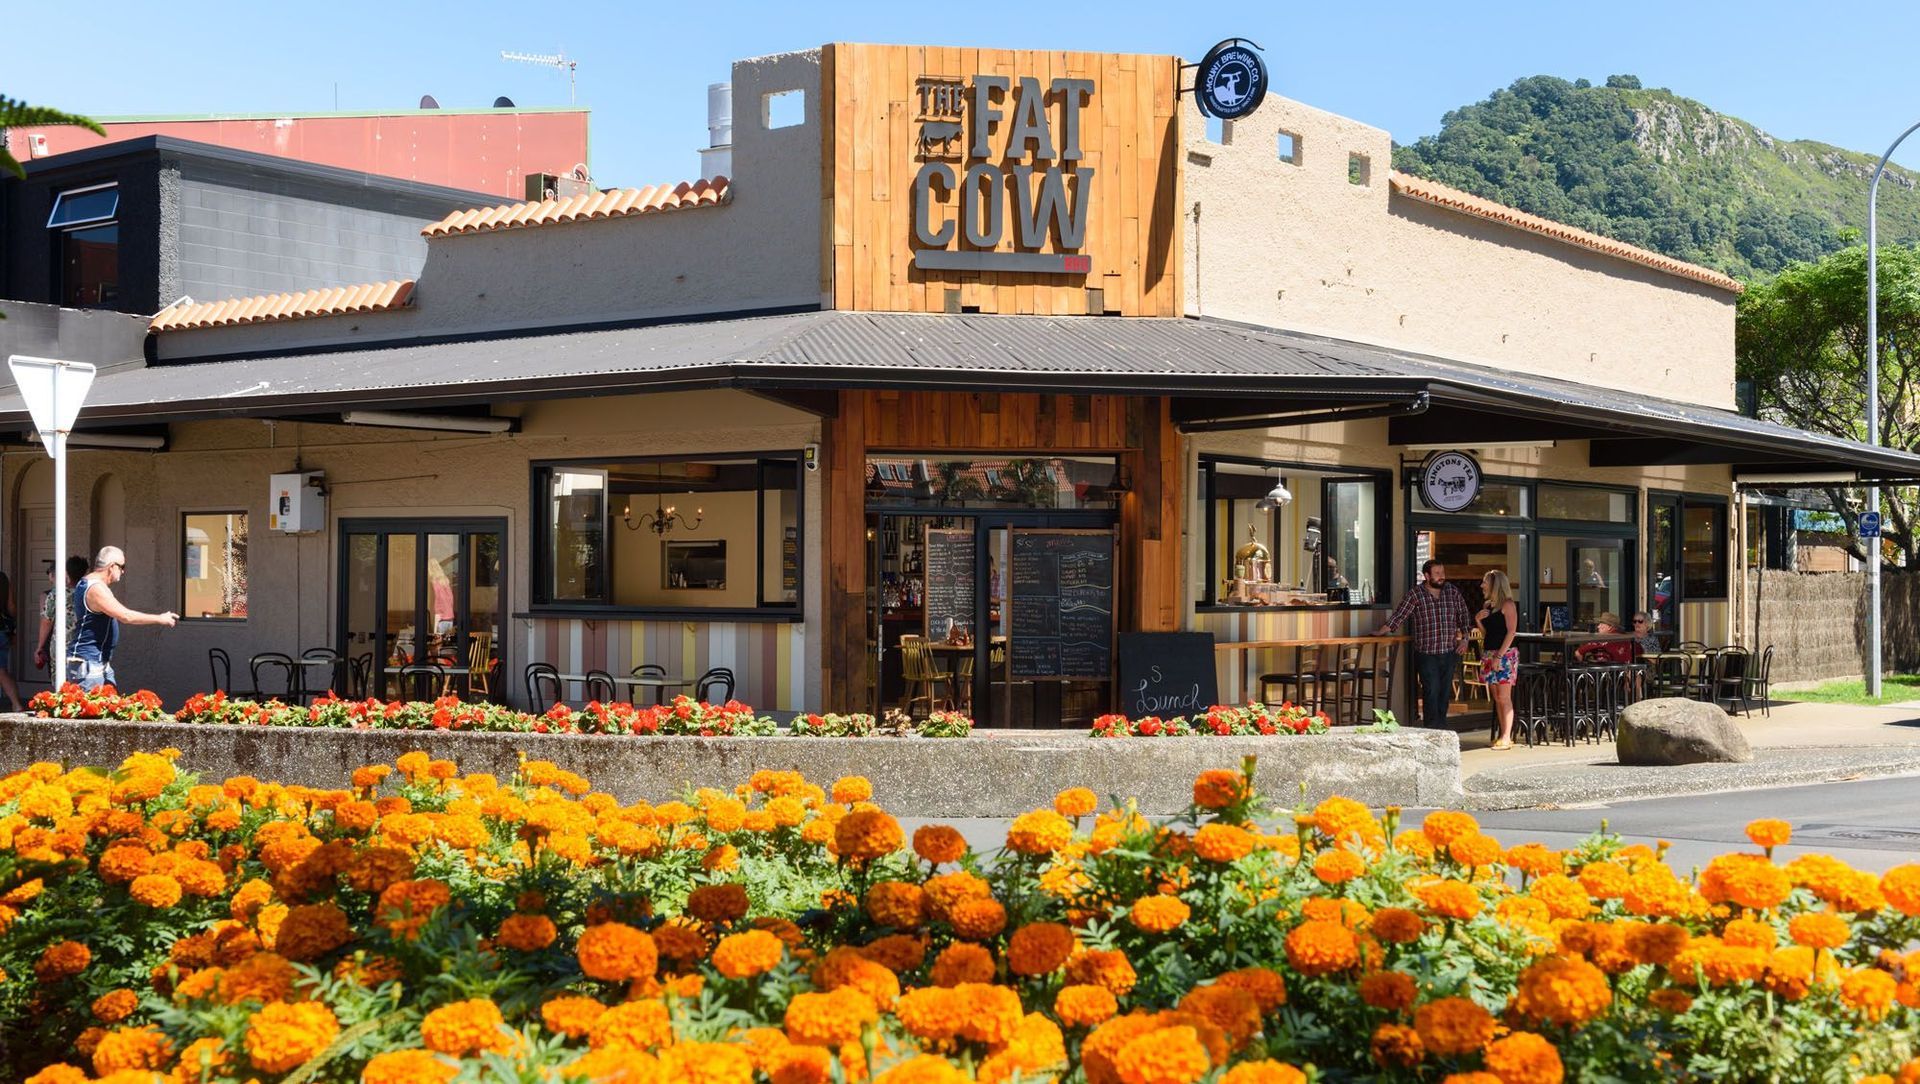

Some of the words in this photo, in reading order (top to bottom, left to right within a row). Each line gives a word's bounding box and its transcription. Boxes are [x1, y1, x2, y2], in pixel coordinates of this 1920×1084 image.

[1206, 60, 1221, 93] MOUNT
[1221, 51, 1255, 69] BREWING
[916, 82, 965, 114] THE
[971, 74, 1095, 160] FAT
[915, 161, 1095, 249] COW
[1429, 458, 1462, 486] RINGTONS
[1462, 463, 1474, 481] TEA
[1131, 678, 1208, 713] Lunch
